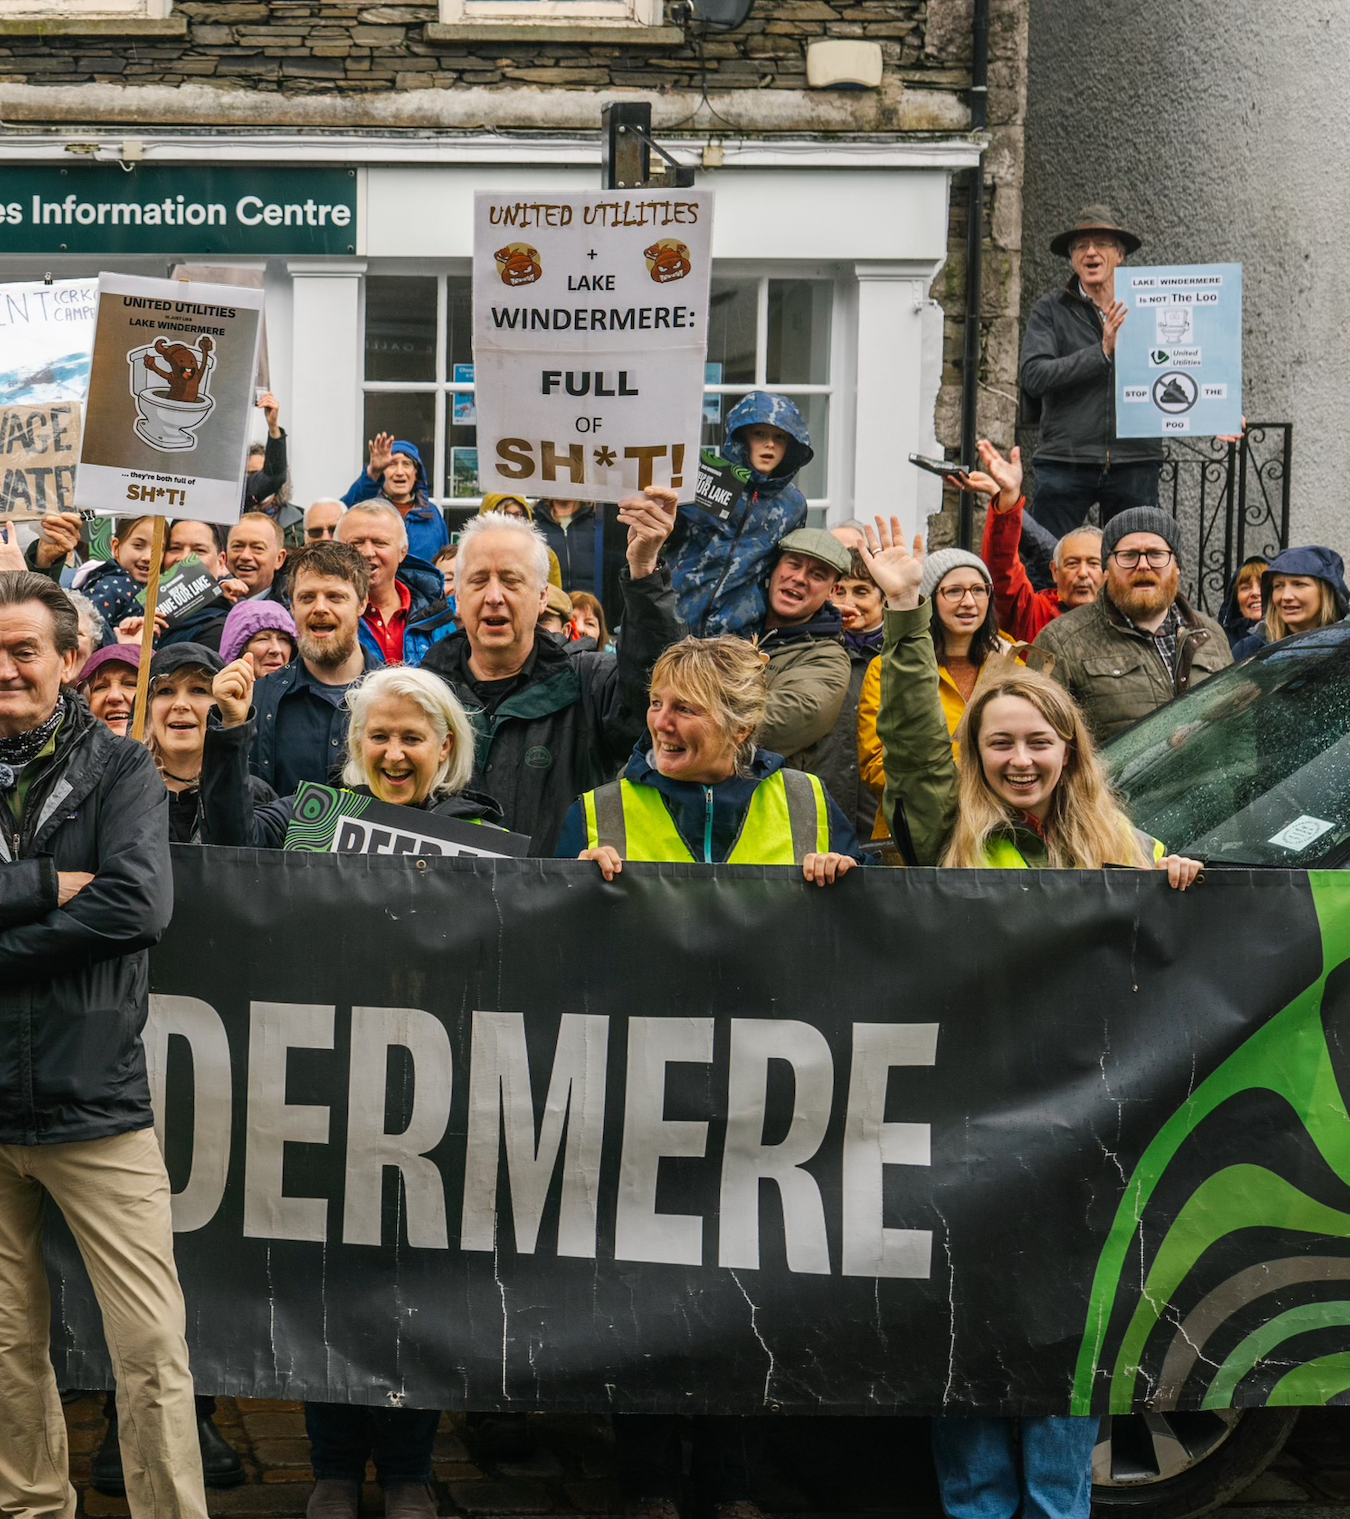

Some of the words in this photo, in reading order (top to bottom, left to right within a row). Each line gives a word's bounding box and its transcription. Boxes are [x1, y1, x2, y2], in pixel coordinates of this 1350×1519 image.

[32, 195, 227, 225] Information
[235, 196, 350, 227] Centre
[489, 202, 573, 228] UNITED
[584, 200, 699, 227] UTILITIES
[568, 275, 616, 291] LAKE
[1160, 277, 1221, 285] WINDERMERE
[123, 296, 172, 311] UNITED
[175, 301, 236, 318] UTILITIES
[1172, 293, 1192, 303] The
[1196, 292, 1217, 302] Loo
[129, 318, 155, 328] LAKE
[157, 321, 225, 336] WINDERMERE
[491, 306, 695, 331] WINDERMERE:
[541, 370, 639, 396] FULL
[575, 417, 603, 433] OF
[130, 471, 155, 481] they're
[156, 474, 173, 482] both
[174, 476, 186, 484] full
[696, 479, 711, 497] UR
[708, 485, 733, 506] LAKE
[173, 588, 194, 607] OUR
[188, 574, 211, 596] LAKE
